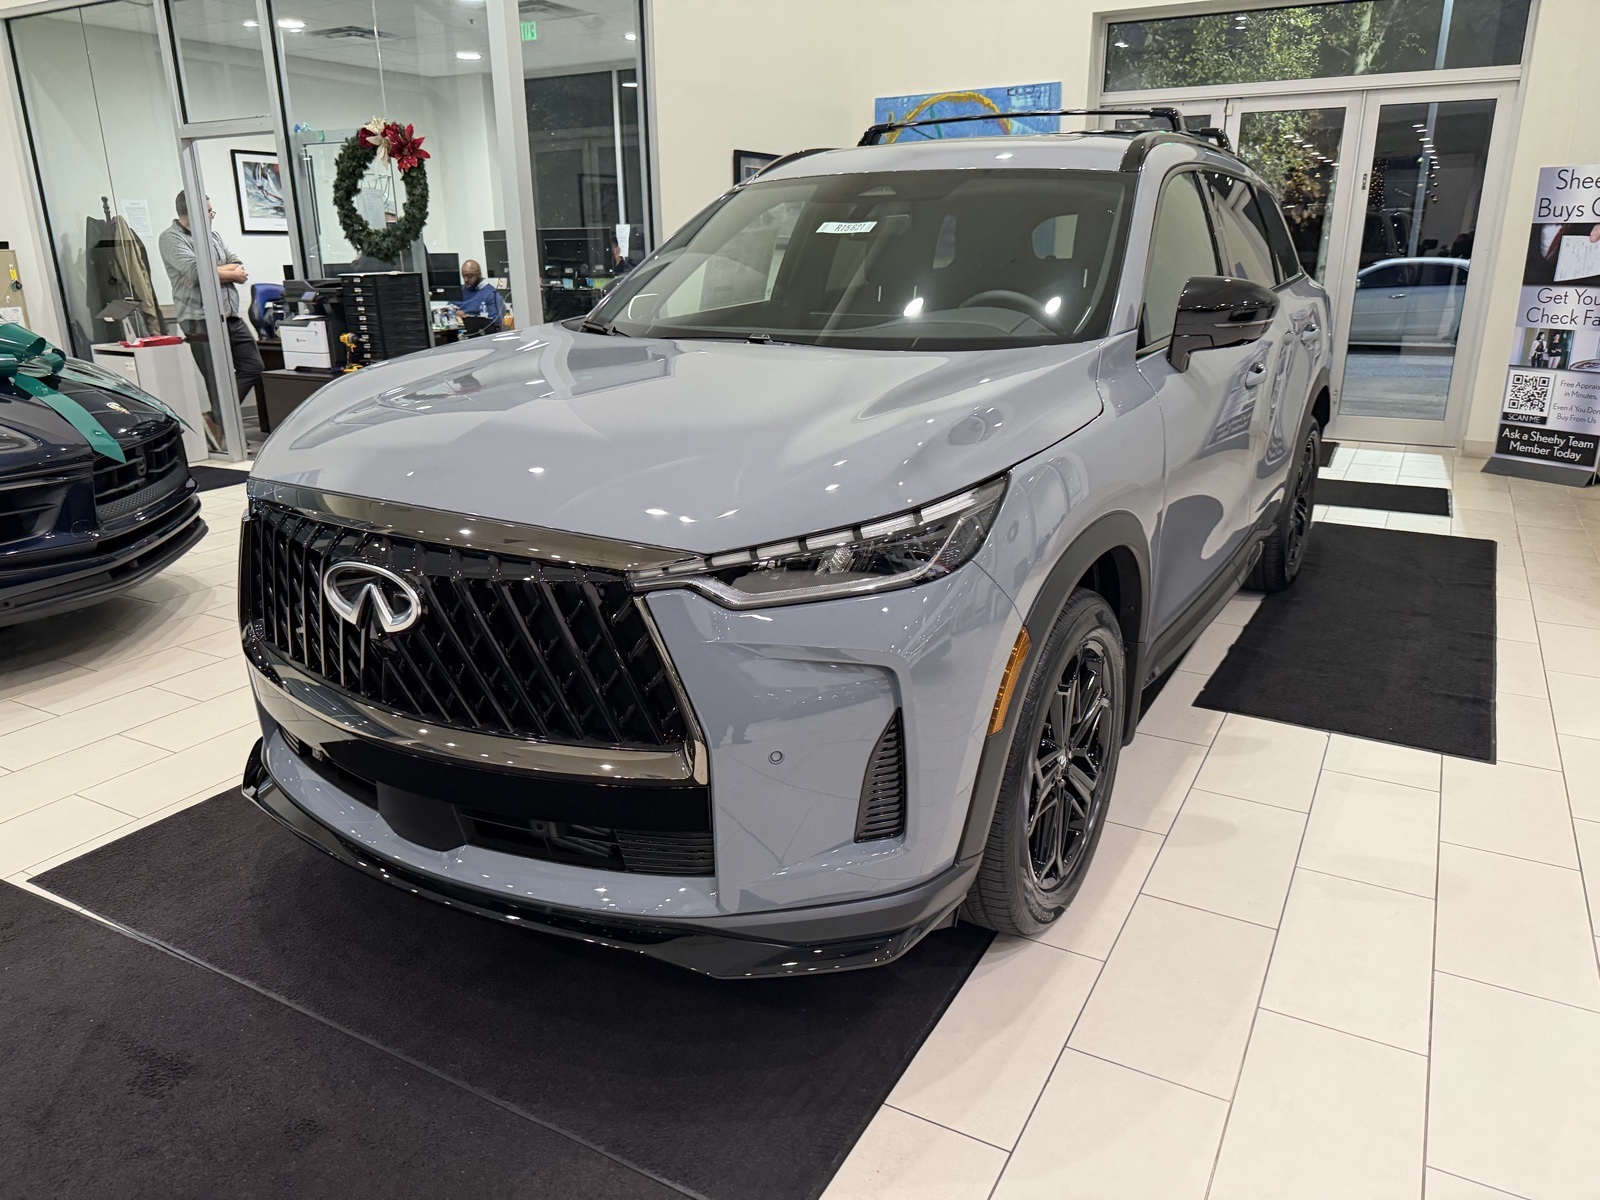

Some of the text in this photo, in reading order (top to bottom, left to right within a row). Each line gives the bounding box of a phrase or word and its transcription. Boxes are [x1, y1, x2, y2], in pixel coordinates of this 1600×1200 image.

[1538, 198, 1585, 222] Buys
[1537, 287, 1569, 305] Get
[1526, 306, 1579, 325] Check
[1560, 379, 1575, 388] Free
[1571, 390, 1598, 401] Minutes,
[1552, 402, 1568, 411] Even
[1574, 405, 1586, 414] You
[1507, 413, 1541, 424] SCAN ME
[1556, 412, 1597, 424] Buy From Us
[1501, 427, 1594, 449] Ask a Sheehy Team
[1509, 440, 1582, 462] Member Today
